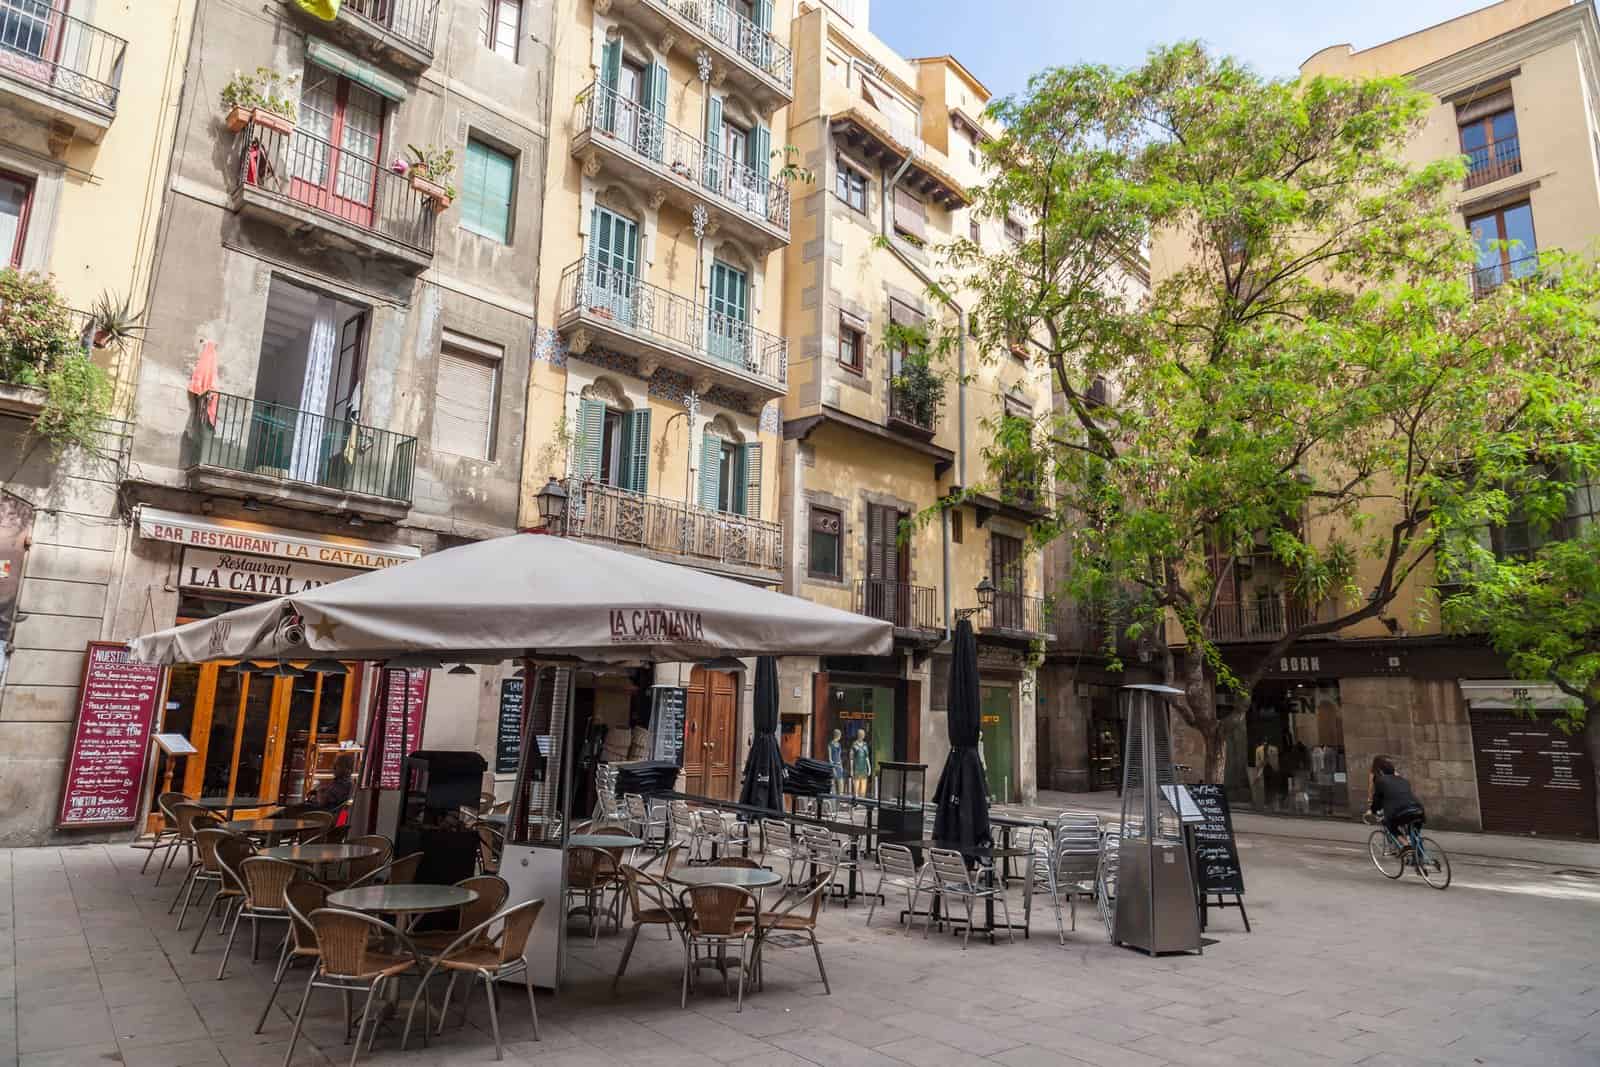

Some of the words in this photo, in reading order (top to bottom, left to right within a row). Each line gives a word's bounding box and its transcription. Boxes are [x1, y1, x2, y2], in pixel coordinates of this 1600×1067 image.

[154, 525, 183, 541] BAR
[191, 531, 279, 553] RESTAURANT
[286, 544, 310, 559] LA
[319, 548, 409, 570] CATALAN
[189, 566, 220, 589] LA
[216, 554, 292, 576] Restaurant
[610, 610, 627, 636] LA
[632, 610, 704, 641] CATALANA
